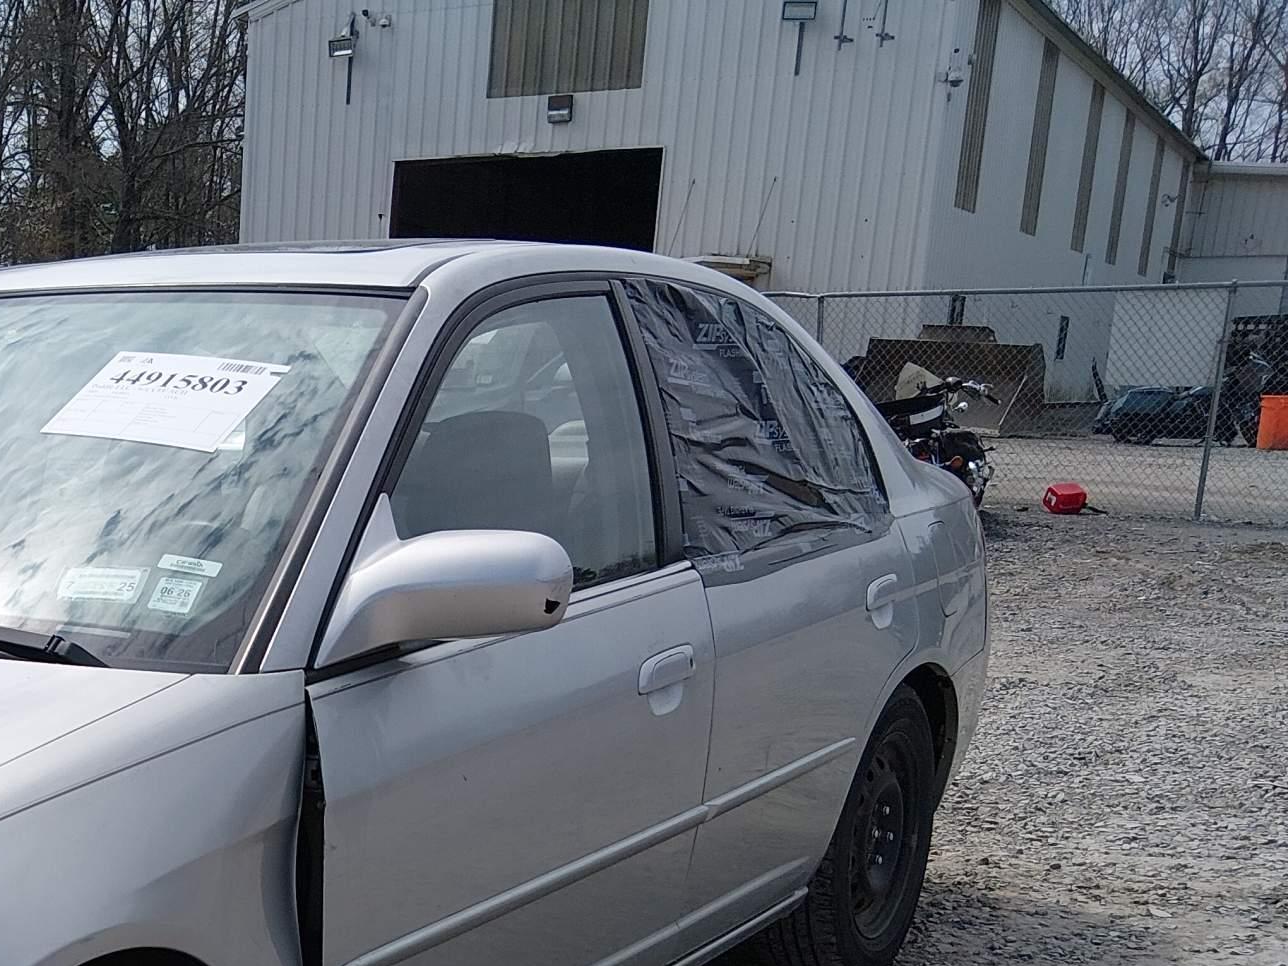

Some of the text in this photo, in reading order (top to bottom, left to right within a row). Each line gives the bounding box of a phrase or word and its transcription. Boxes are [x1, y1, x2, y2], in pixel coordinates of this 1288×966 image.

[110, 369, 248, 395] 44915803
[117, 582, 137, 592] 25
[160, 586, 175, 596] 06
